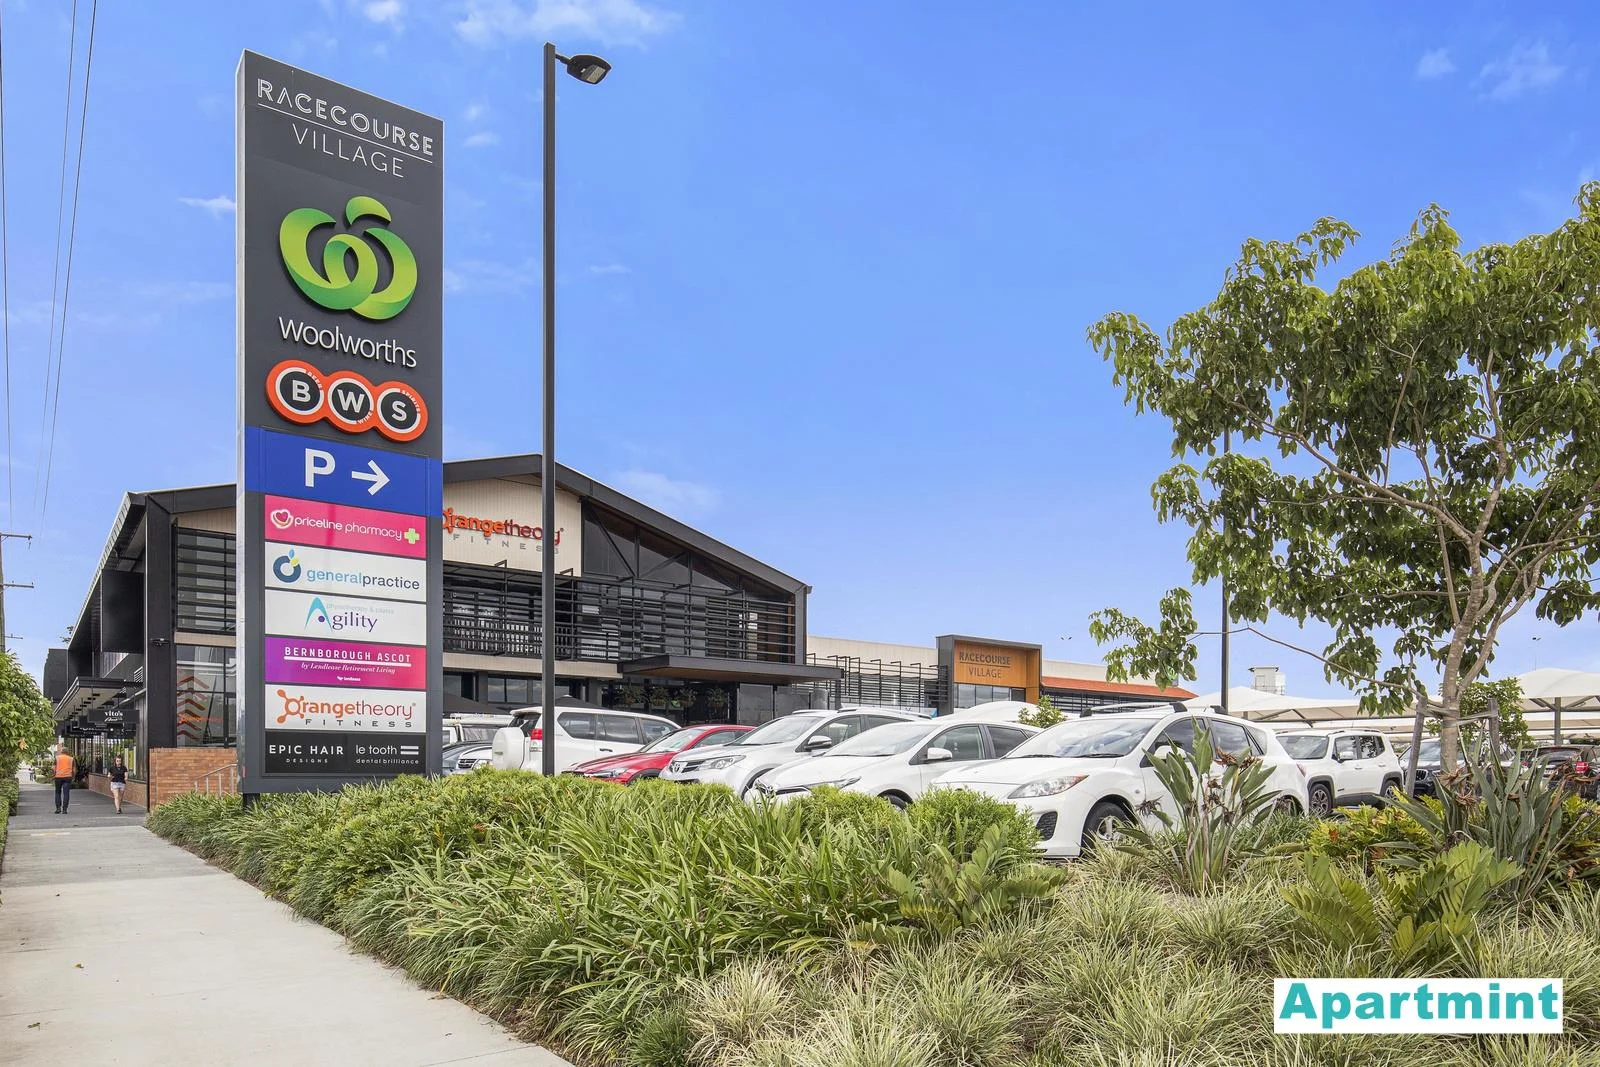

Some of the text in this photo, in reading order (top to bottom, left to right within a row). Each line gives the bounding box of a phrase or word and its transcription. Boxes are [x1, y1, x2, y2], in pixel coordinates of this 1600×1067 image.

[257, 78, 433, 156] RACECOURSE
[292, 123, 404, 178] VILLAGE
[278, 316, 417, 368] Woolworths
[304, 447, 336, 488] P
[294, 516, 403, 541] priceline pharmacy
[304, 597, 378, 632] Agility
[284, 646, 411, 663] BERNBOROUGH ASCOT
[959, 651, 1011, 666] RACECOURSE
[301, 662, 396, 675] by Lendlease Retirement Living
[968, 666, 1002, 679] VILLAGE
[305, 718, 412, 728] FITNESS
[269, 744, 344, 755] EPIC HAIR
[355, 744, 398, 755] le tooth
